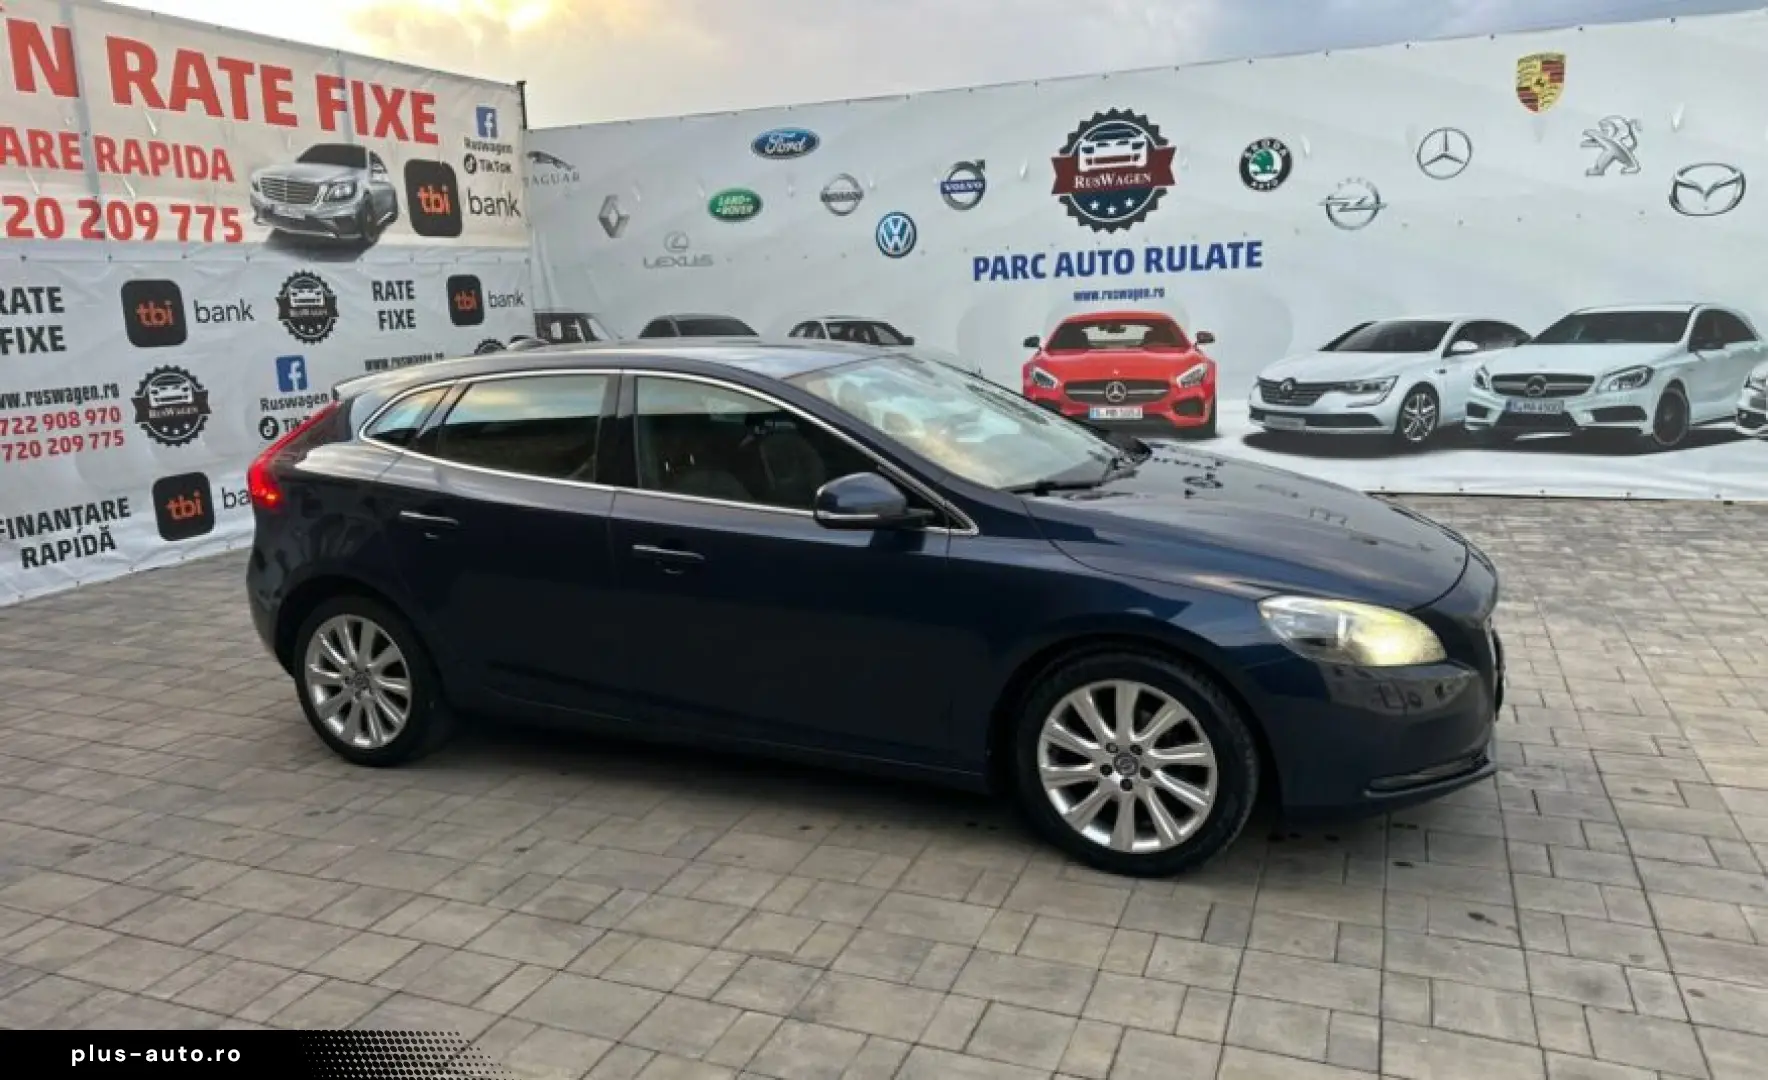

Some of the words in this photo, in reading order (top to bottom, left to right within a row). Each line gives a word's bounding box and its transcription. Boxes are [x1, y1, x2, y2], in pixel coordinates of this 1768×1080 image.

[3, 15, 80, 98] N
[106, 35, 298, 129] RATE
[315, 74, 438, 145] FIXE
[764, 131, 806, 154] Ford
[93, 134, 235, 183] RAPIDA
[479, 158, 512, 173] TikTok
[943, 183, 984, 191] VOLVO
[417, 186, 452, 215] tbi
[467, 188, 522, 217] bank
[78, 198, 158, 241] 209
[169, 203, 243, 243] 775
[643, 254, 713, 269] LEXUS
[972, 253, 1046, 282] PARC
[1054, 248, 1135, 278] AUTO
[1144, 240, 1263, 274] RULATE
[371, 279, 415, 301] RATE
[487, 290, 525, 308] bank
[135, 300, 174, 327] tbi
[193, 299, 255, 324] bank
[377, 308, 416, 331] FIXE
[260, 392, 328, 411] Ruswagen
[42, 410, 81, 431] 908
[84, 405, 121, 426] 970
[47, 434, 84, 457] 209
[88, 429, 124, 450] 775
[167, 491, 204, 521] tbi
[221, 487, 249, 510] ba
[21, 525, 117, 570] RAPIDĂ
